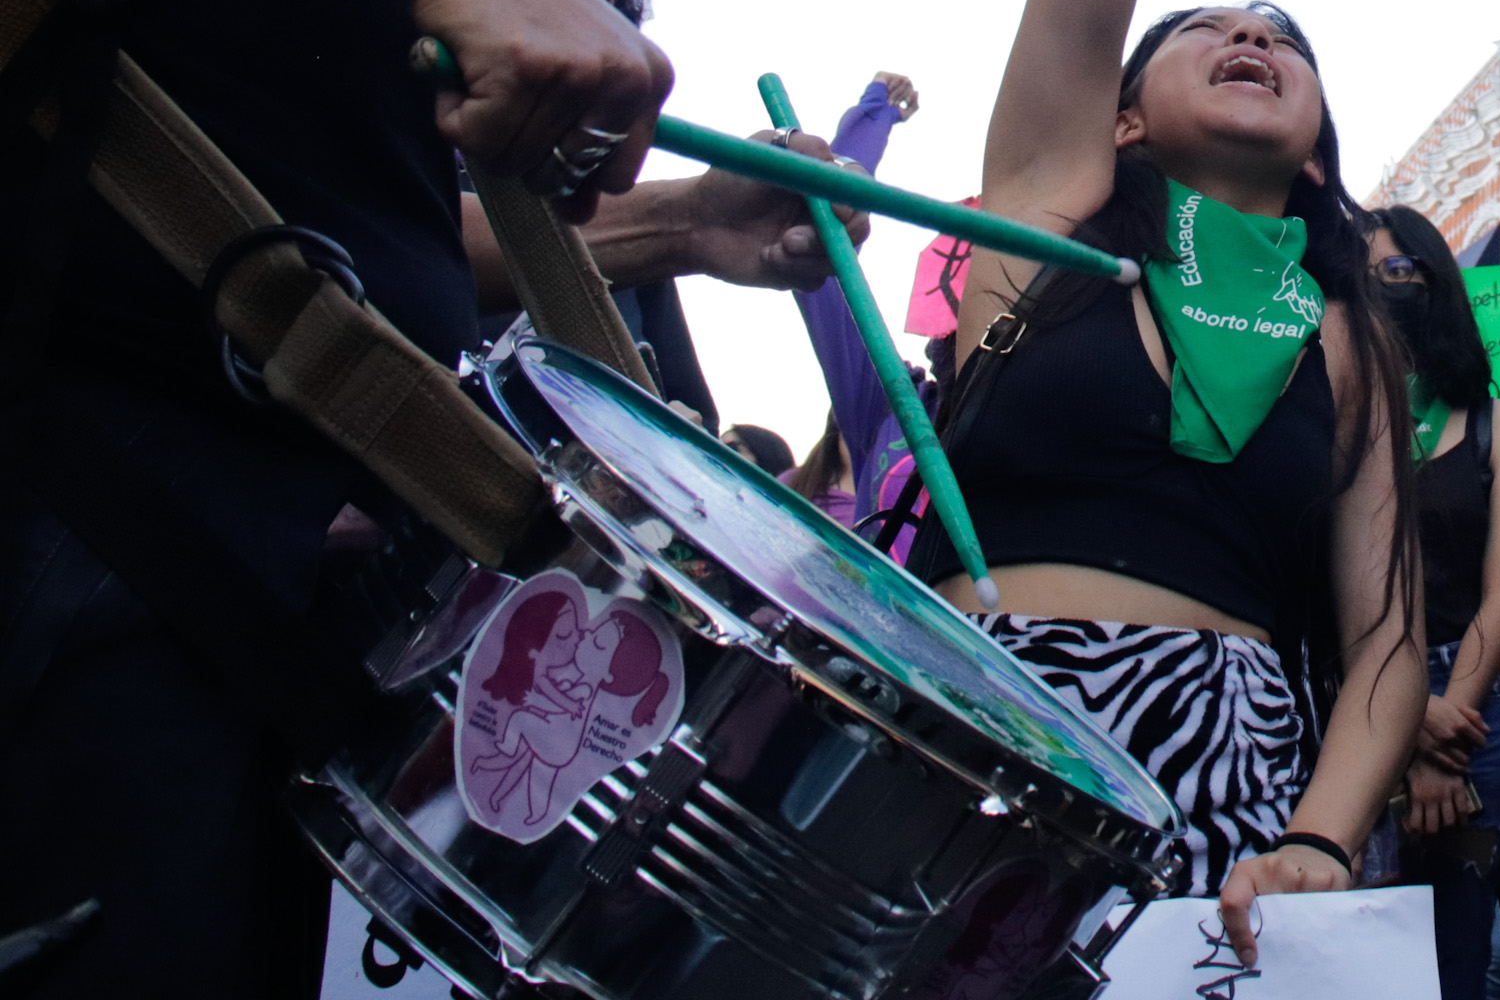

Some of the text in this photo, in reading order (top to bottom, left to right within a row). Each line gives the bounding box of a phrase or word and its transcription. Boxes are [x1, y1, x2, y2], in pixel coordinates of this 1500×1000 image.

[1175, 194, 1204, 287] Educación
[1181, 305, 1306, 339] aborto legal
[588, 726, 626, 749] Nuestro
[593, 714, 632, 738] Amar es
[582, 737, 624, 763] Derecho
